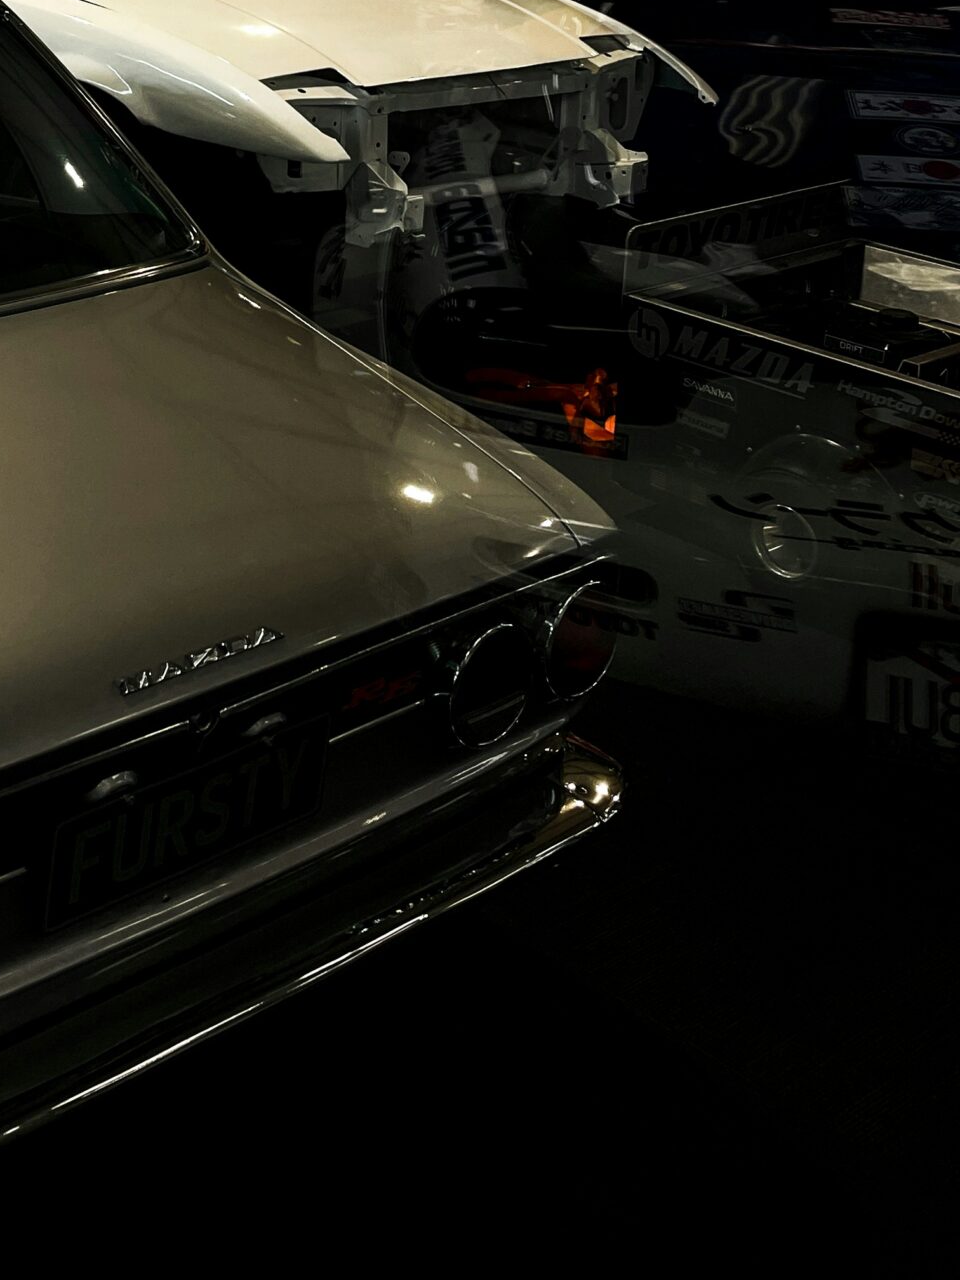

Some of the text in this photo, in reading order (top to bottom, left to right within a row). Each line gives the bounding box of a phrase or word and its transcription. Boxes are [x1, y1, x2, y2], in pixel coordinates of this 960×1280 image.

[672, 324, 817, 395] MAZDA
[681, 376, 735, 402] SAVANNA
[836, 379, 960, 430] Hampton Dow
[118, 625, 285, 698] MAZDA
[65, 735, 311, 904] FURSTY
